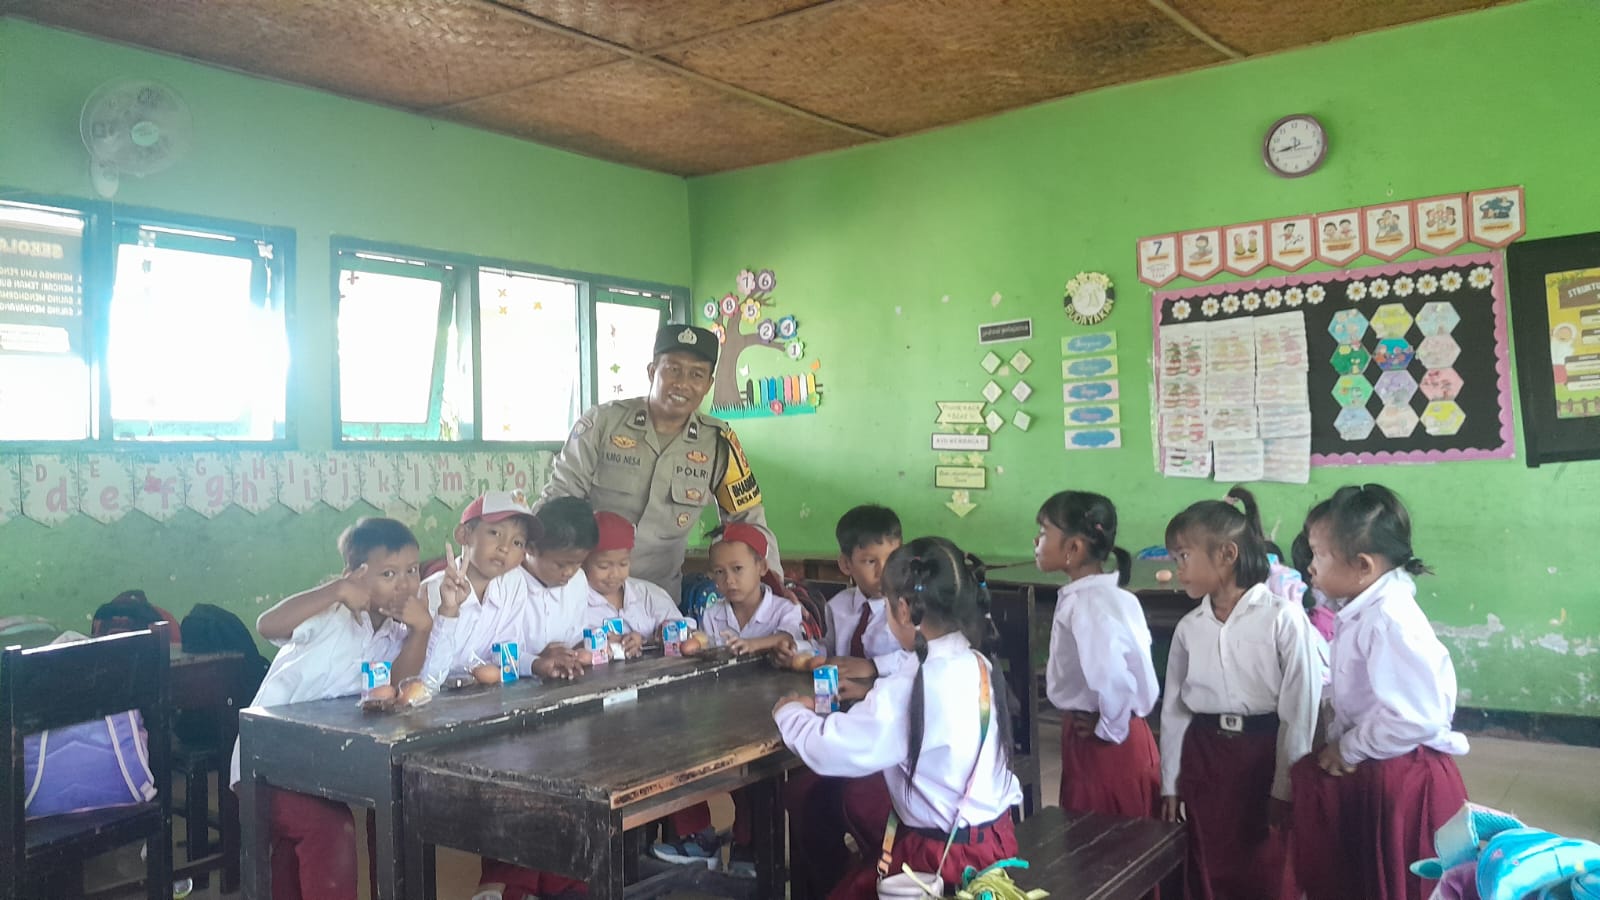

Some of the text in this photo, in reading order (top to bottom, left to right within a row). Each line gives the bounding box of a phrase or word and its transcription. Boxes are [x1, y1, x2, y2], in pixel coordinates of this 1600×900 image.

[1152, 240, 1163, 256] 7
[195, 458, 224, 508] G g
[241, 457, 266, 504] H h
[328, 457, 350, 501] J j
[378, 469, 391, 493] k
[406, 456, 413, 471] L
[437, 456, 463, 492] M m
[676, 465, 709, 479] POLRI
[35, 463, 68, 513] D d
[90, 459, 119, 511] E e
